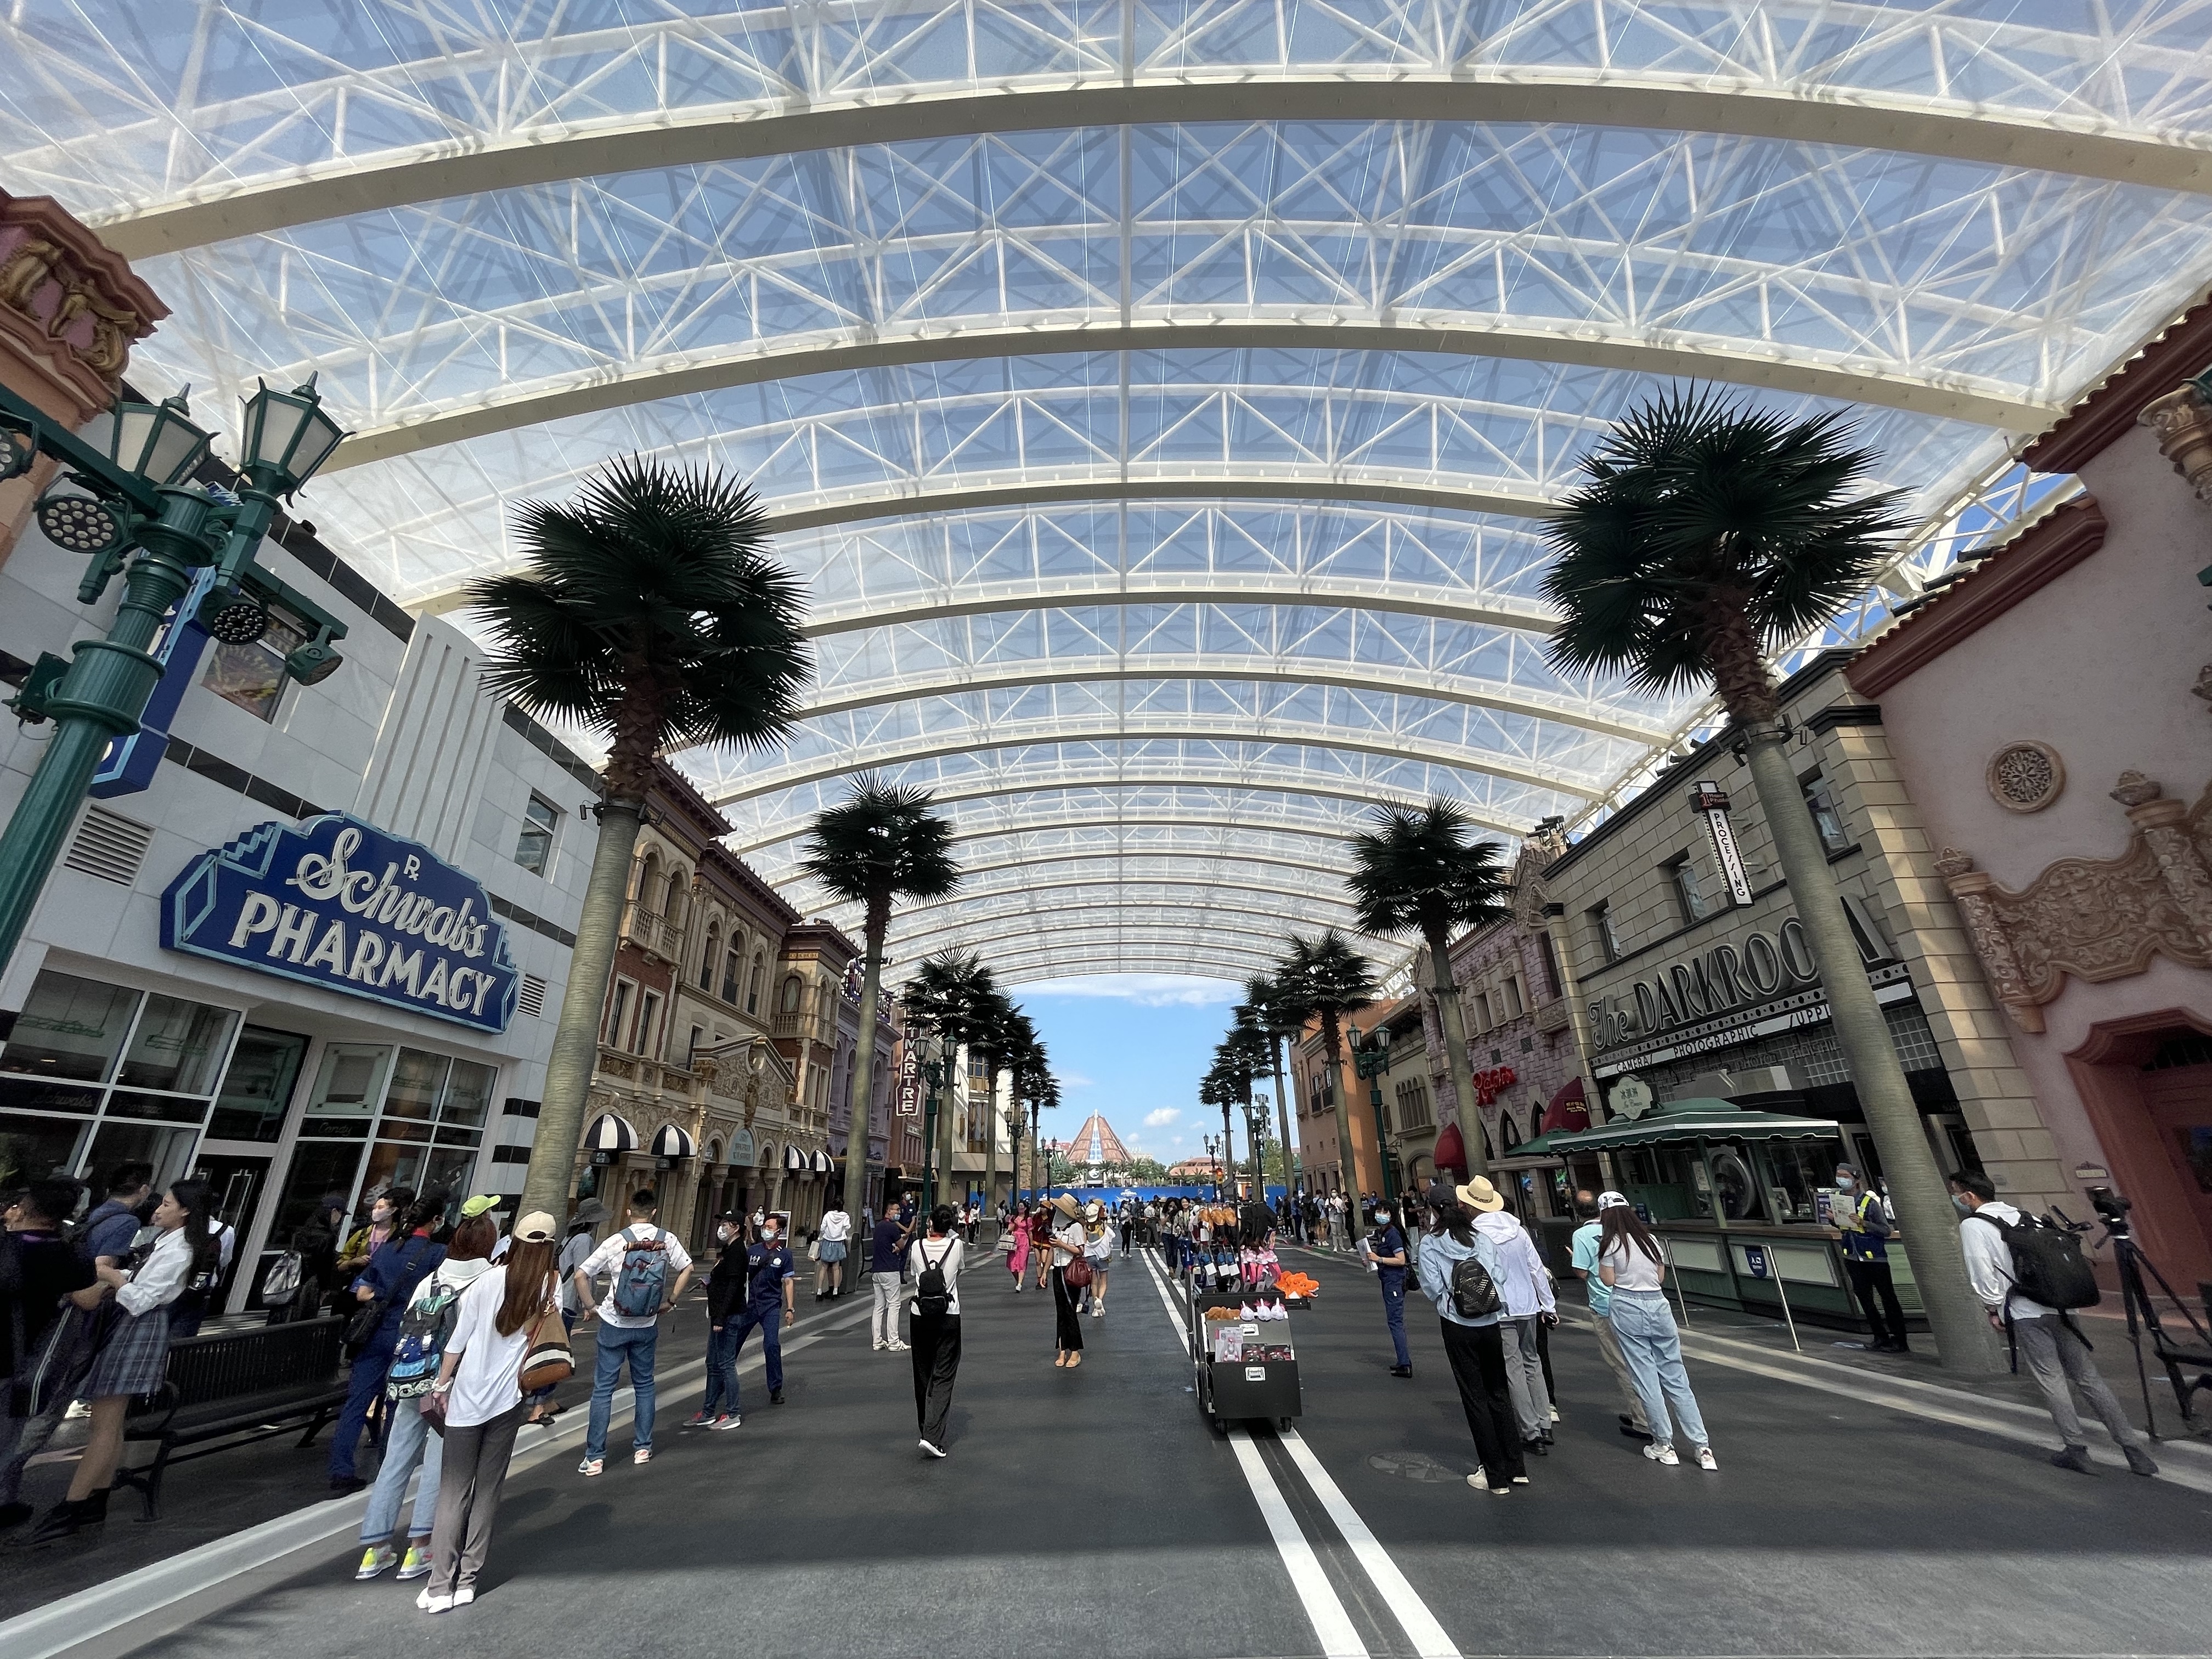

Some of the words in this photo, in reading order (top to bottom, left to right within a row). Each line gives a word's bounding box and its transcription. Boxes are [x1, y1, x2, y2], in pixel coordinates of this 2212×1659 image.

[285, 827, 488, 958] Schwab's
[228, 889, 496, 1016] PHARMACY
[1588, 995, 1631, 1051] The
[1673, 1024, 1759, 1058] PHOTOGRAPHIC
